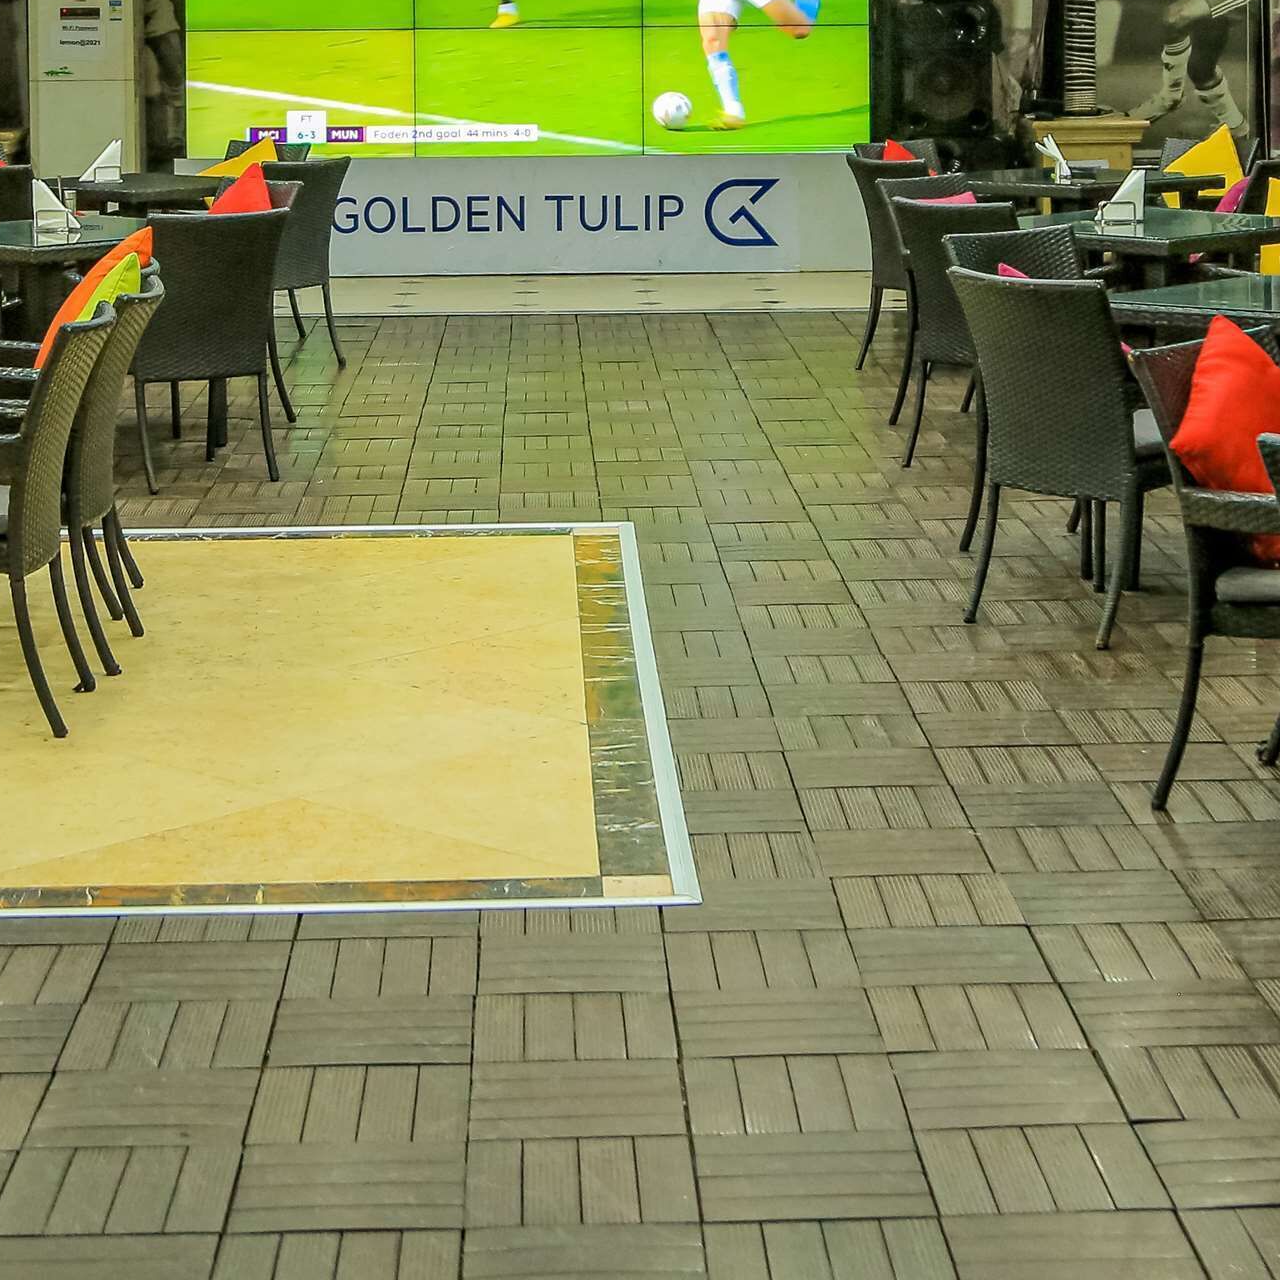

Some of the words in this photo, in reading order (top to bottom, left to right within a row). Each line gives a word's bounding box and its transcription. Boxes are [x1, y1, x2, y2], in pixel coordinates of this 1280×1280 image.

[300, 114, 313, 123] FT
[257, 130, 280, 141] MCI
[331, 129, 358, 139] MUN
[373, 129, 408, 139] Foden
[411, 129, 433, 139] 2nd
[436, 128, 461, 140] goal
[481, 128, 509, 137] mins
[332, 196, 525, 233] GOLDEN
[545, 195, 684, 232] TULIP
